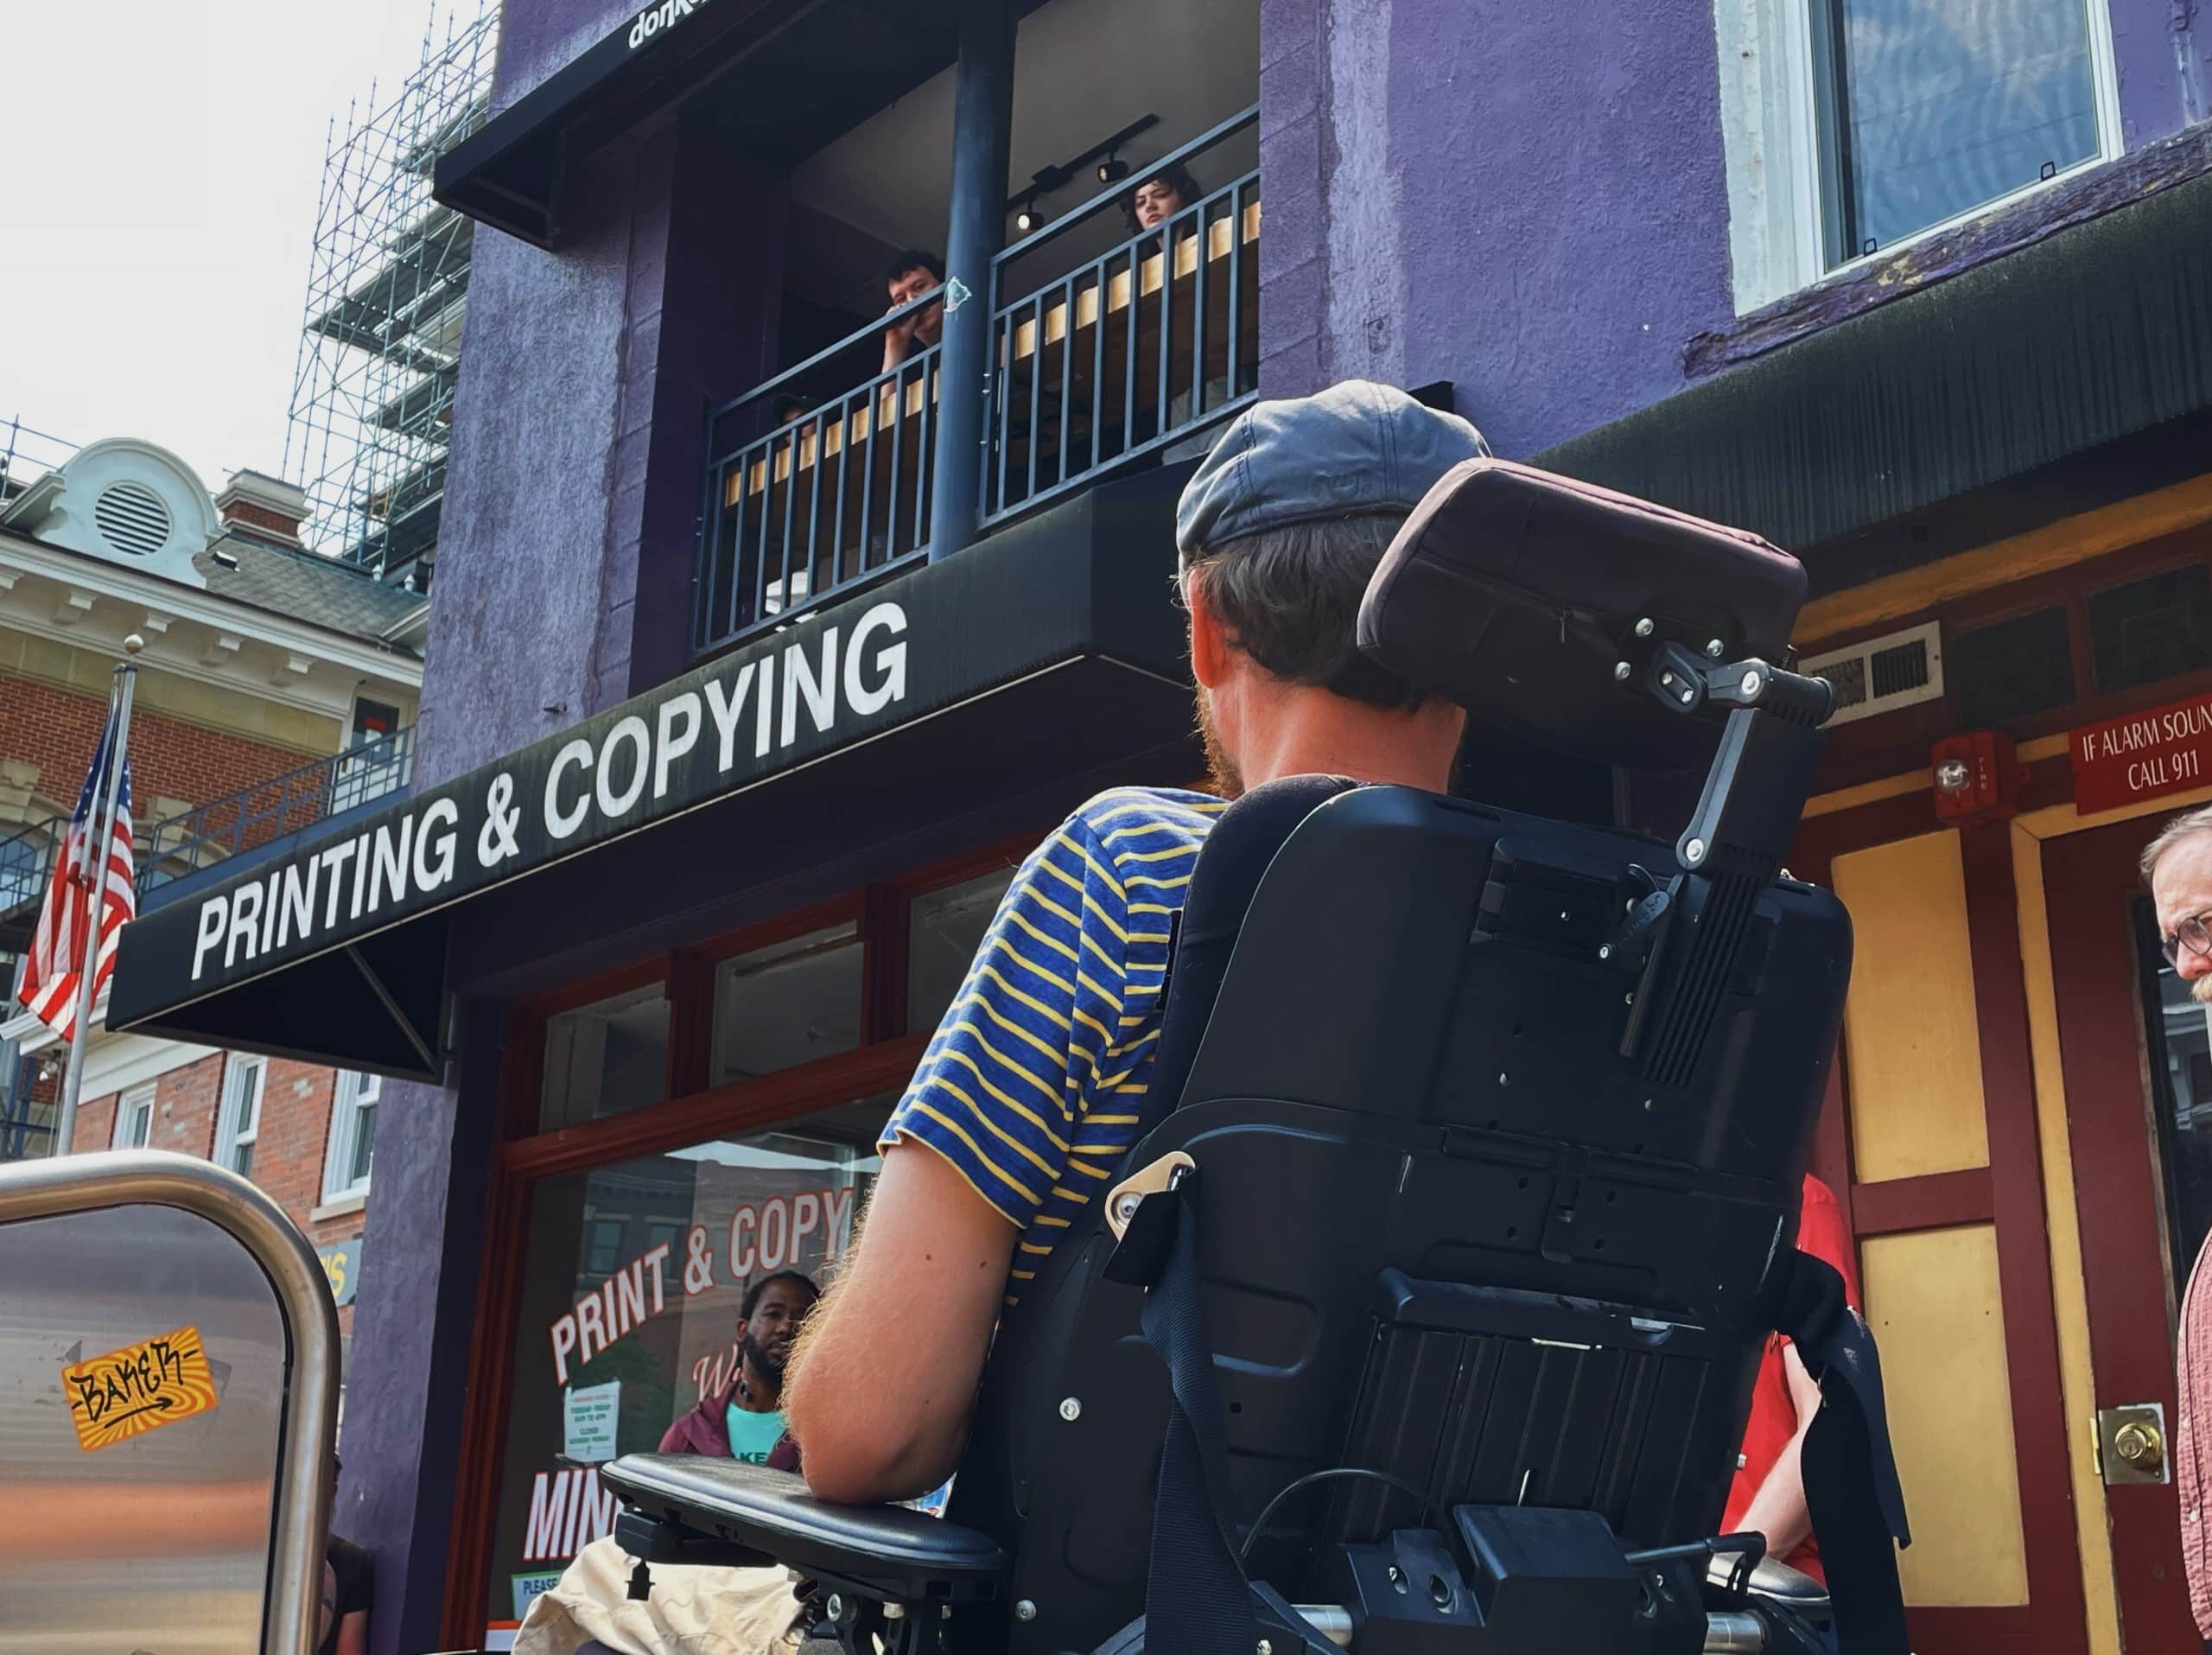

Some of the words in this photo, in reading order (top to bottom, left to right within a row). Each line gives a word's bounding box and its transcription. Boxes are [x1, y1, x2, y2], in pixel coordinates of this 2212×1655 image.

[192, 797, 459, 981] PRINTING
[478, 772, 520, 867] &
[544, 602, 908, 839] COPYING
[2082, 734, 2096, 761] IF
[2102, 718, 2161, 758] ALARM
[2128, 757, 2169, 790] CALL
[2172, 748, 2199, 780] 911
[550, 1243, 670, 1386] PRINT
[683, 1225, 715, 1295] &
[730, 1187, 855, 1279] COPY
